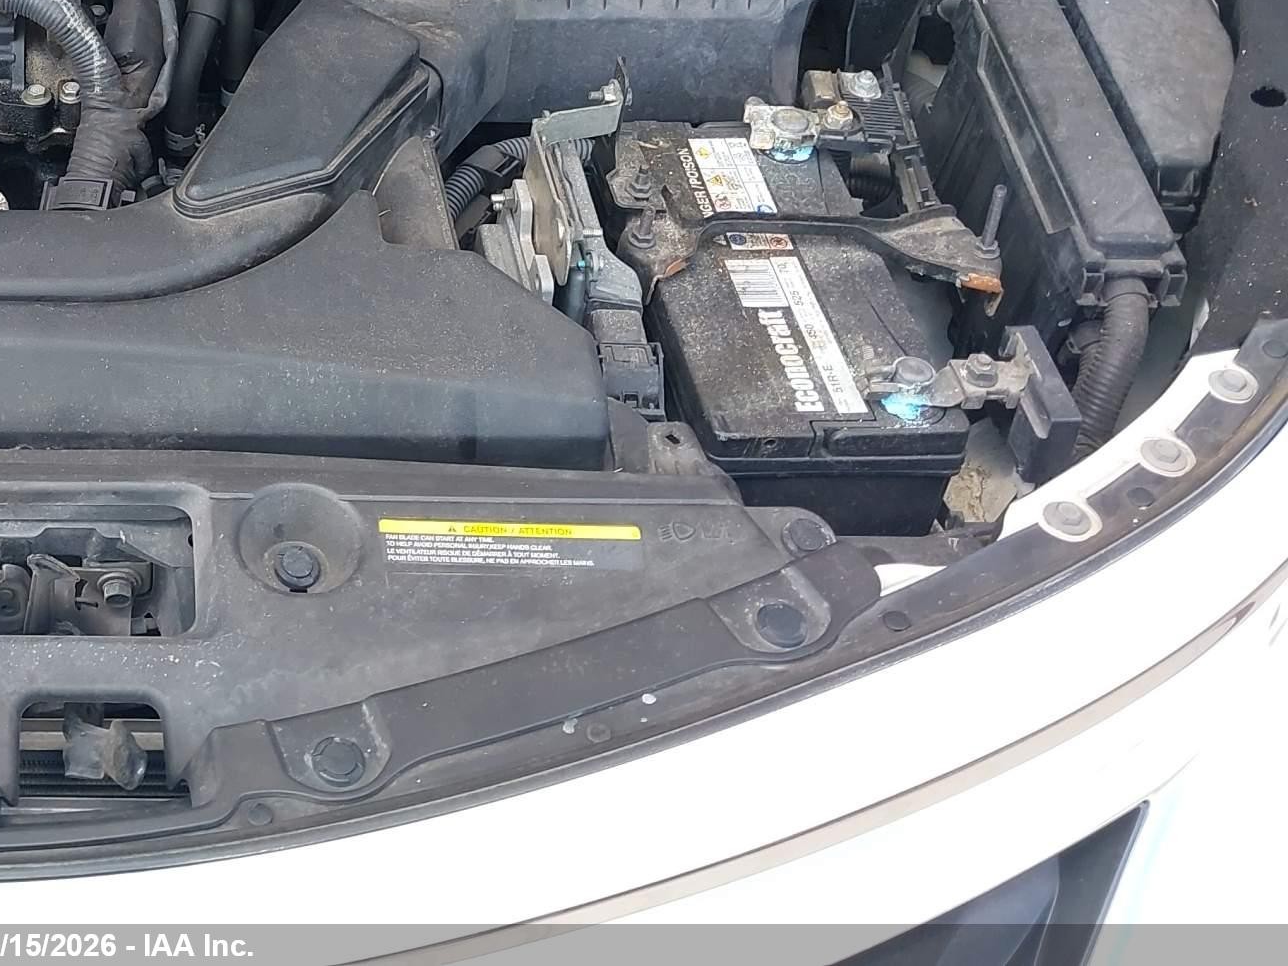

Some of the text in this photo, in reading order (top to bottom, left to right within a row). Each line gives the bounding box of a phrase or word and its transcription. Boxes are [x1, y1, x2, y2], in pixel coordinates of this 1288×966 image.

[694, 190, 715, 218] NGER
[758, 308, 825, 412] Econocraft
[464, 525, 507, 534] CAUTION
[519, 527, 572, 536] ATTENTION
